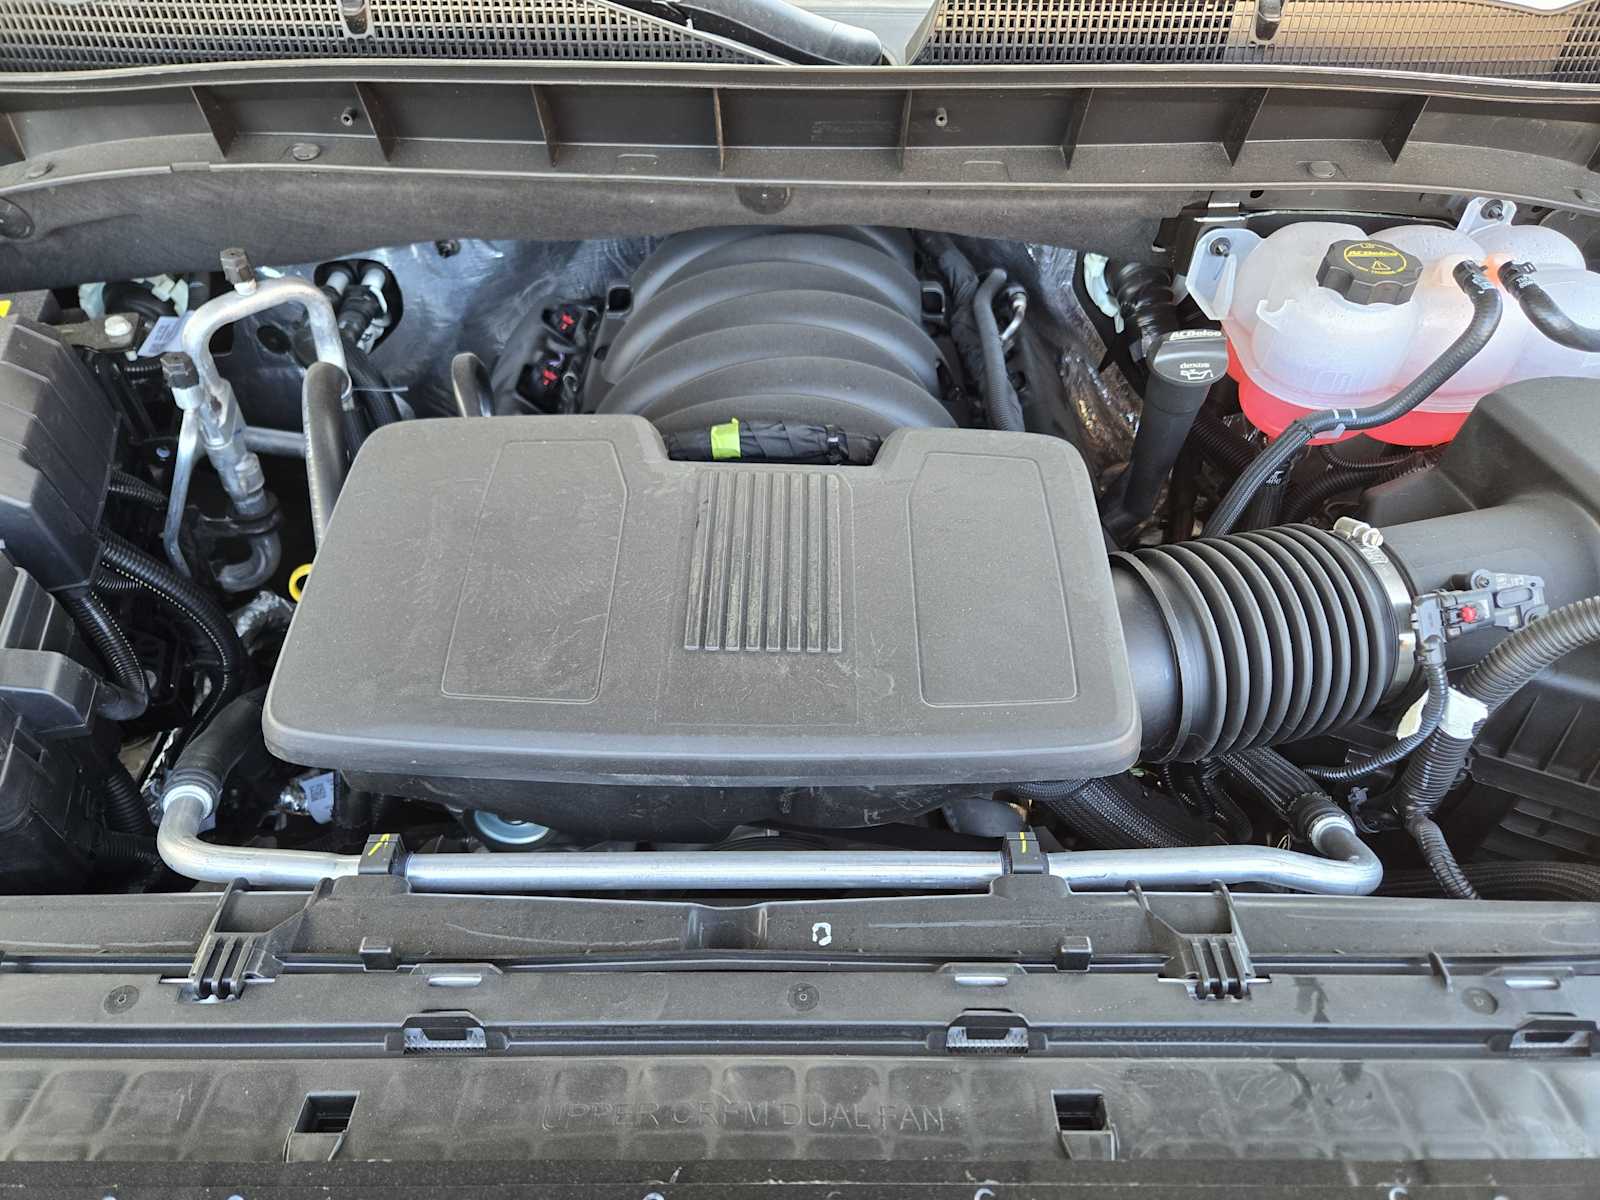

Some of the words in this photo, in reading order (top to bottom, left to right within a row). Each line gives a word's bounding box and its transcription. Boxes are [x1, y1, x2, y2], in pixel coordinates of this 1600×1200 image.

[1169, 329, 1222, 341] ACDelco
[541, 1101, 660, 1131] UPPER
[782, 1102, 871, 1129] DUAL
[879, 1103, 945, 1133] FAN
